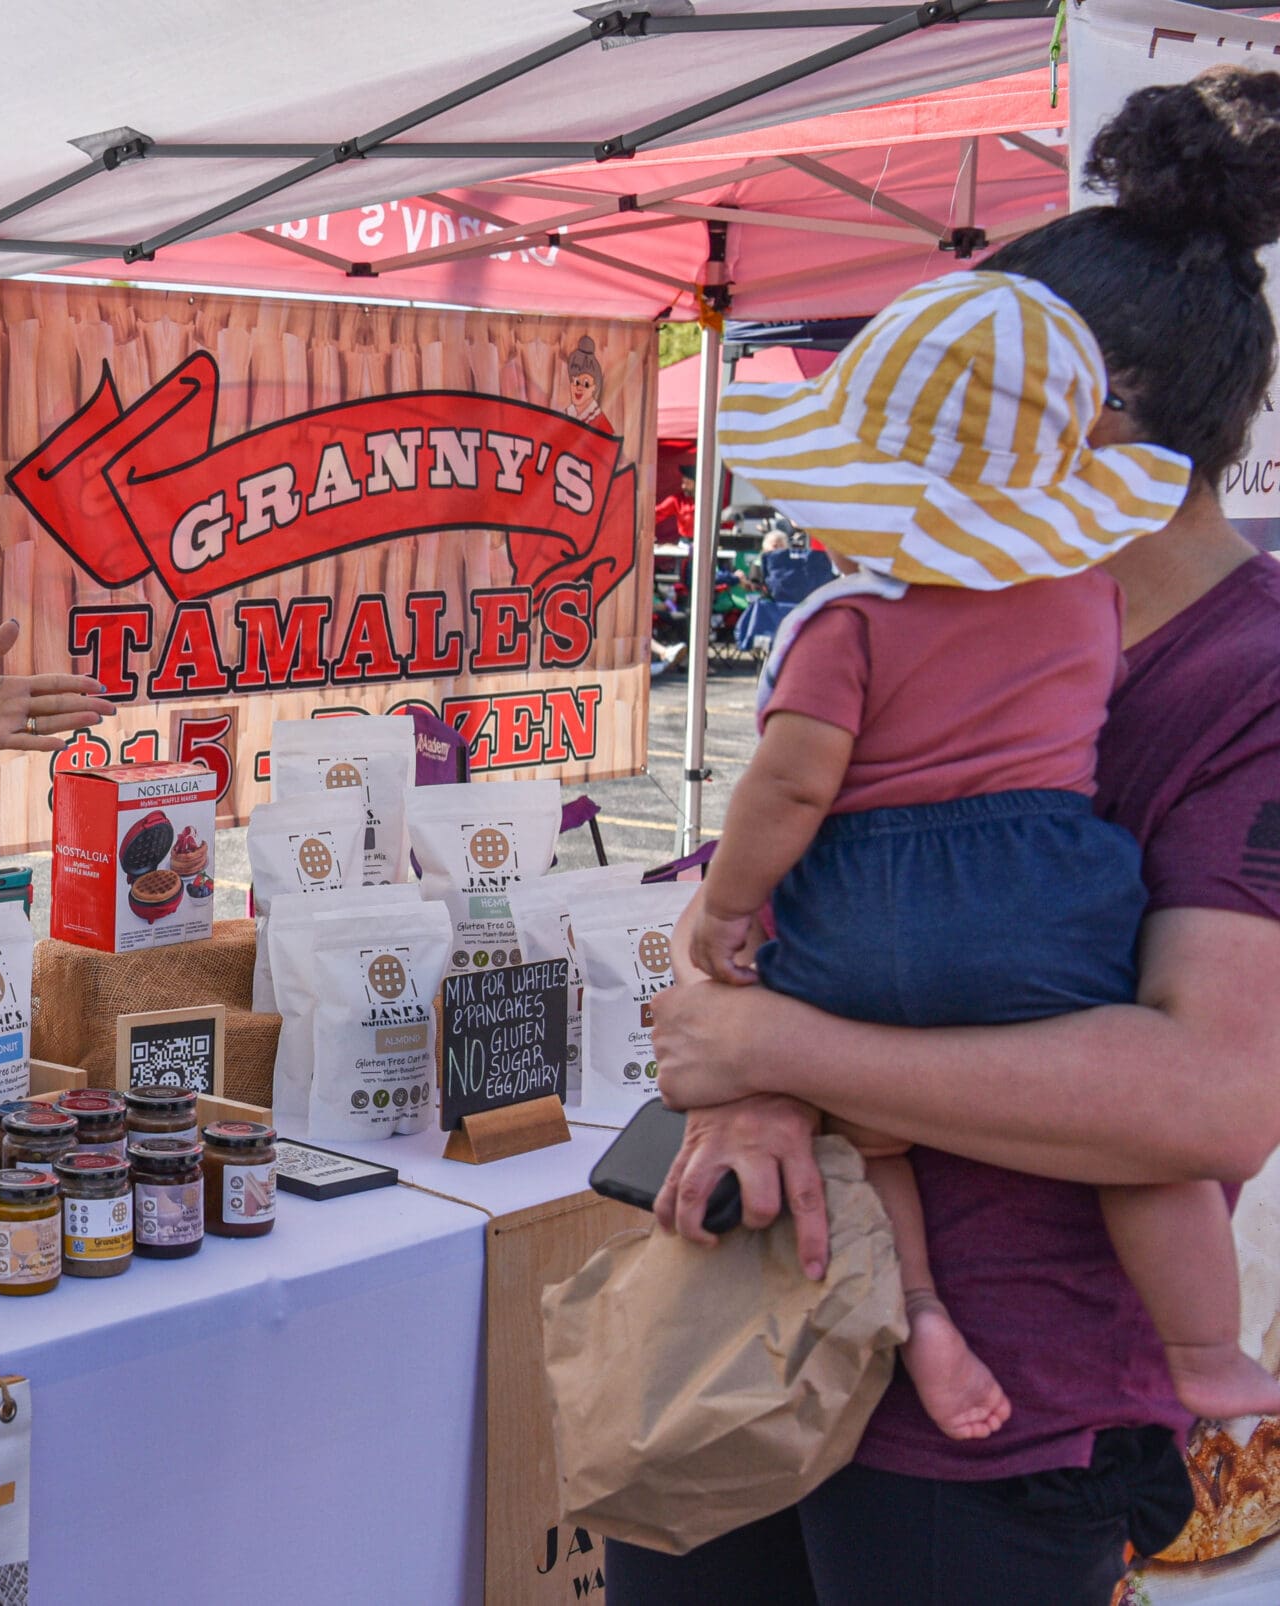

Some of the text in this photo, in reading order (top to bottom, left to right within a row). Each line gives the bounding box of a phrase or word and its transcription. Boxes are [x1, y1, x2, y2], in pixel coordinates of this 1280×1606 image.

[171, 429, 595, 573] GRANNY'S
[69, 580, 594, 700] TAMALES
[457, 921, 485, 932] Gluten
[487, 921, 504, 930] Free
[445, 962, 567, 1008] MIX FOR WAFFLES
[368, 1005, 424, 1020] JANI'S
[356, 1058, 385, 1069] Gluten
[388, 1056, 405, 1066] Free
[407, 1055, 420, 1064] Oat
[448, 1018, 545, 1097] NO GLUTEN
[489, 1044, 544, 1077] SUGAR
[486, 1062, 560, 1099] EGG/DAIRY
